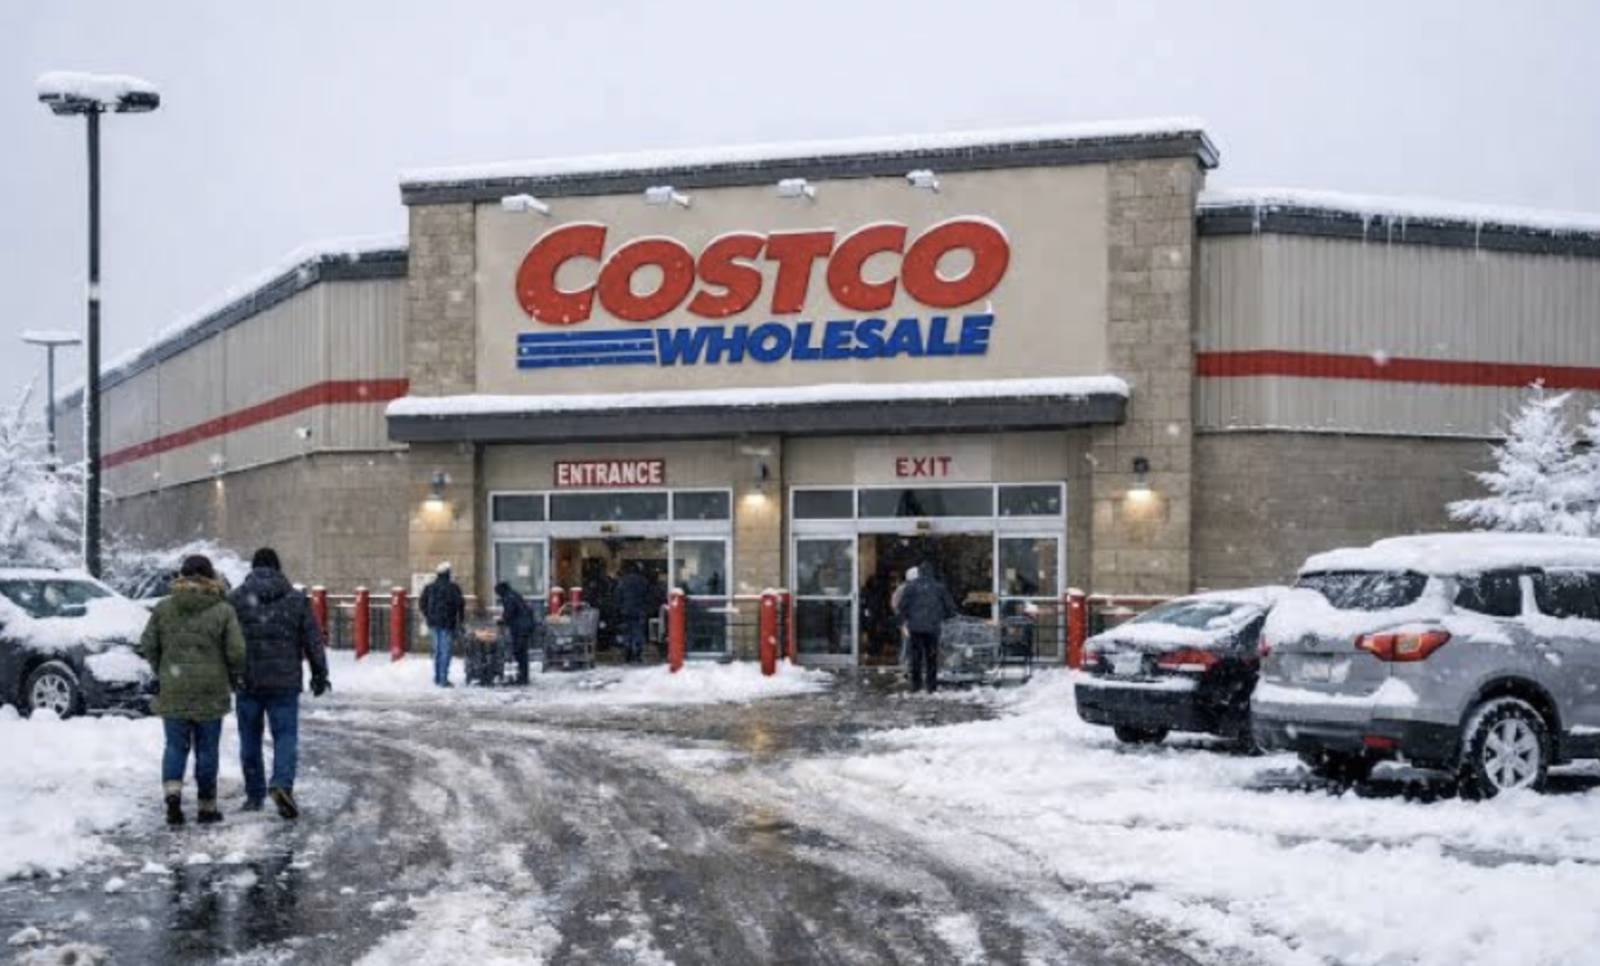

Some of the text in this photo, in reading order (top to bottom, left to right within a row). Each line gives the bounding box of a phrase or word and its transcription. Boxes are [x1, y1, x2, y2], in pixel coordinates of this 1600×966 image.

[515, 220, 1010, 325] COSTCO
[656, 313, 994, 366] WHOLESALE
[558, 461, 662, 484] ENTRANCE
[896, 457, 952, 477] EXIT
